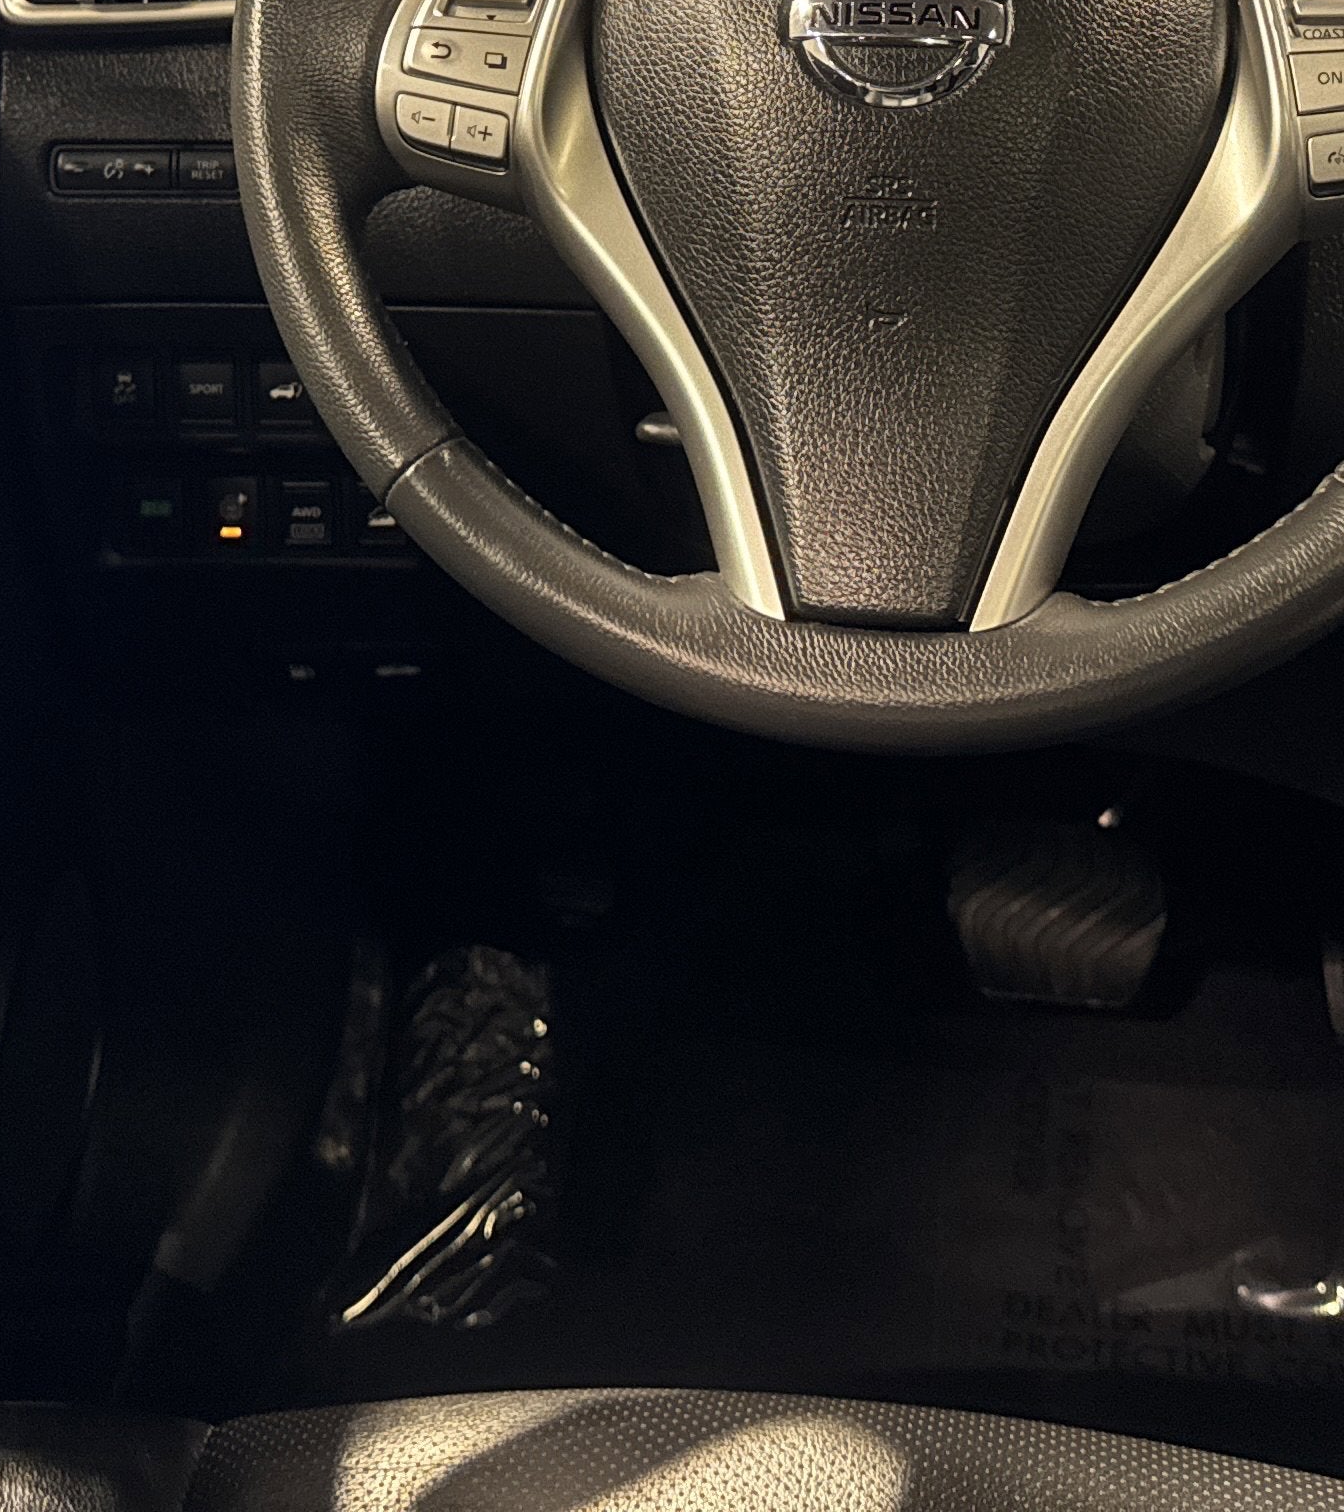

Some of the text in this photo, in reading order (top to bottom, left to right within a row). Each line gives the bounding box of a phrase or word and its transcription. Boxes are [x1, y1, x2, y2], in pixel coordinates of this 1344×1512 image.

[809, 1, 981, 30] NISSAN
[197, 160, 219, 170] TRIP
[191, 170, 224, 180] RESET
[189, 383, 224, 395] SPORT
[291, 507, 323, 518] AWD
